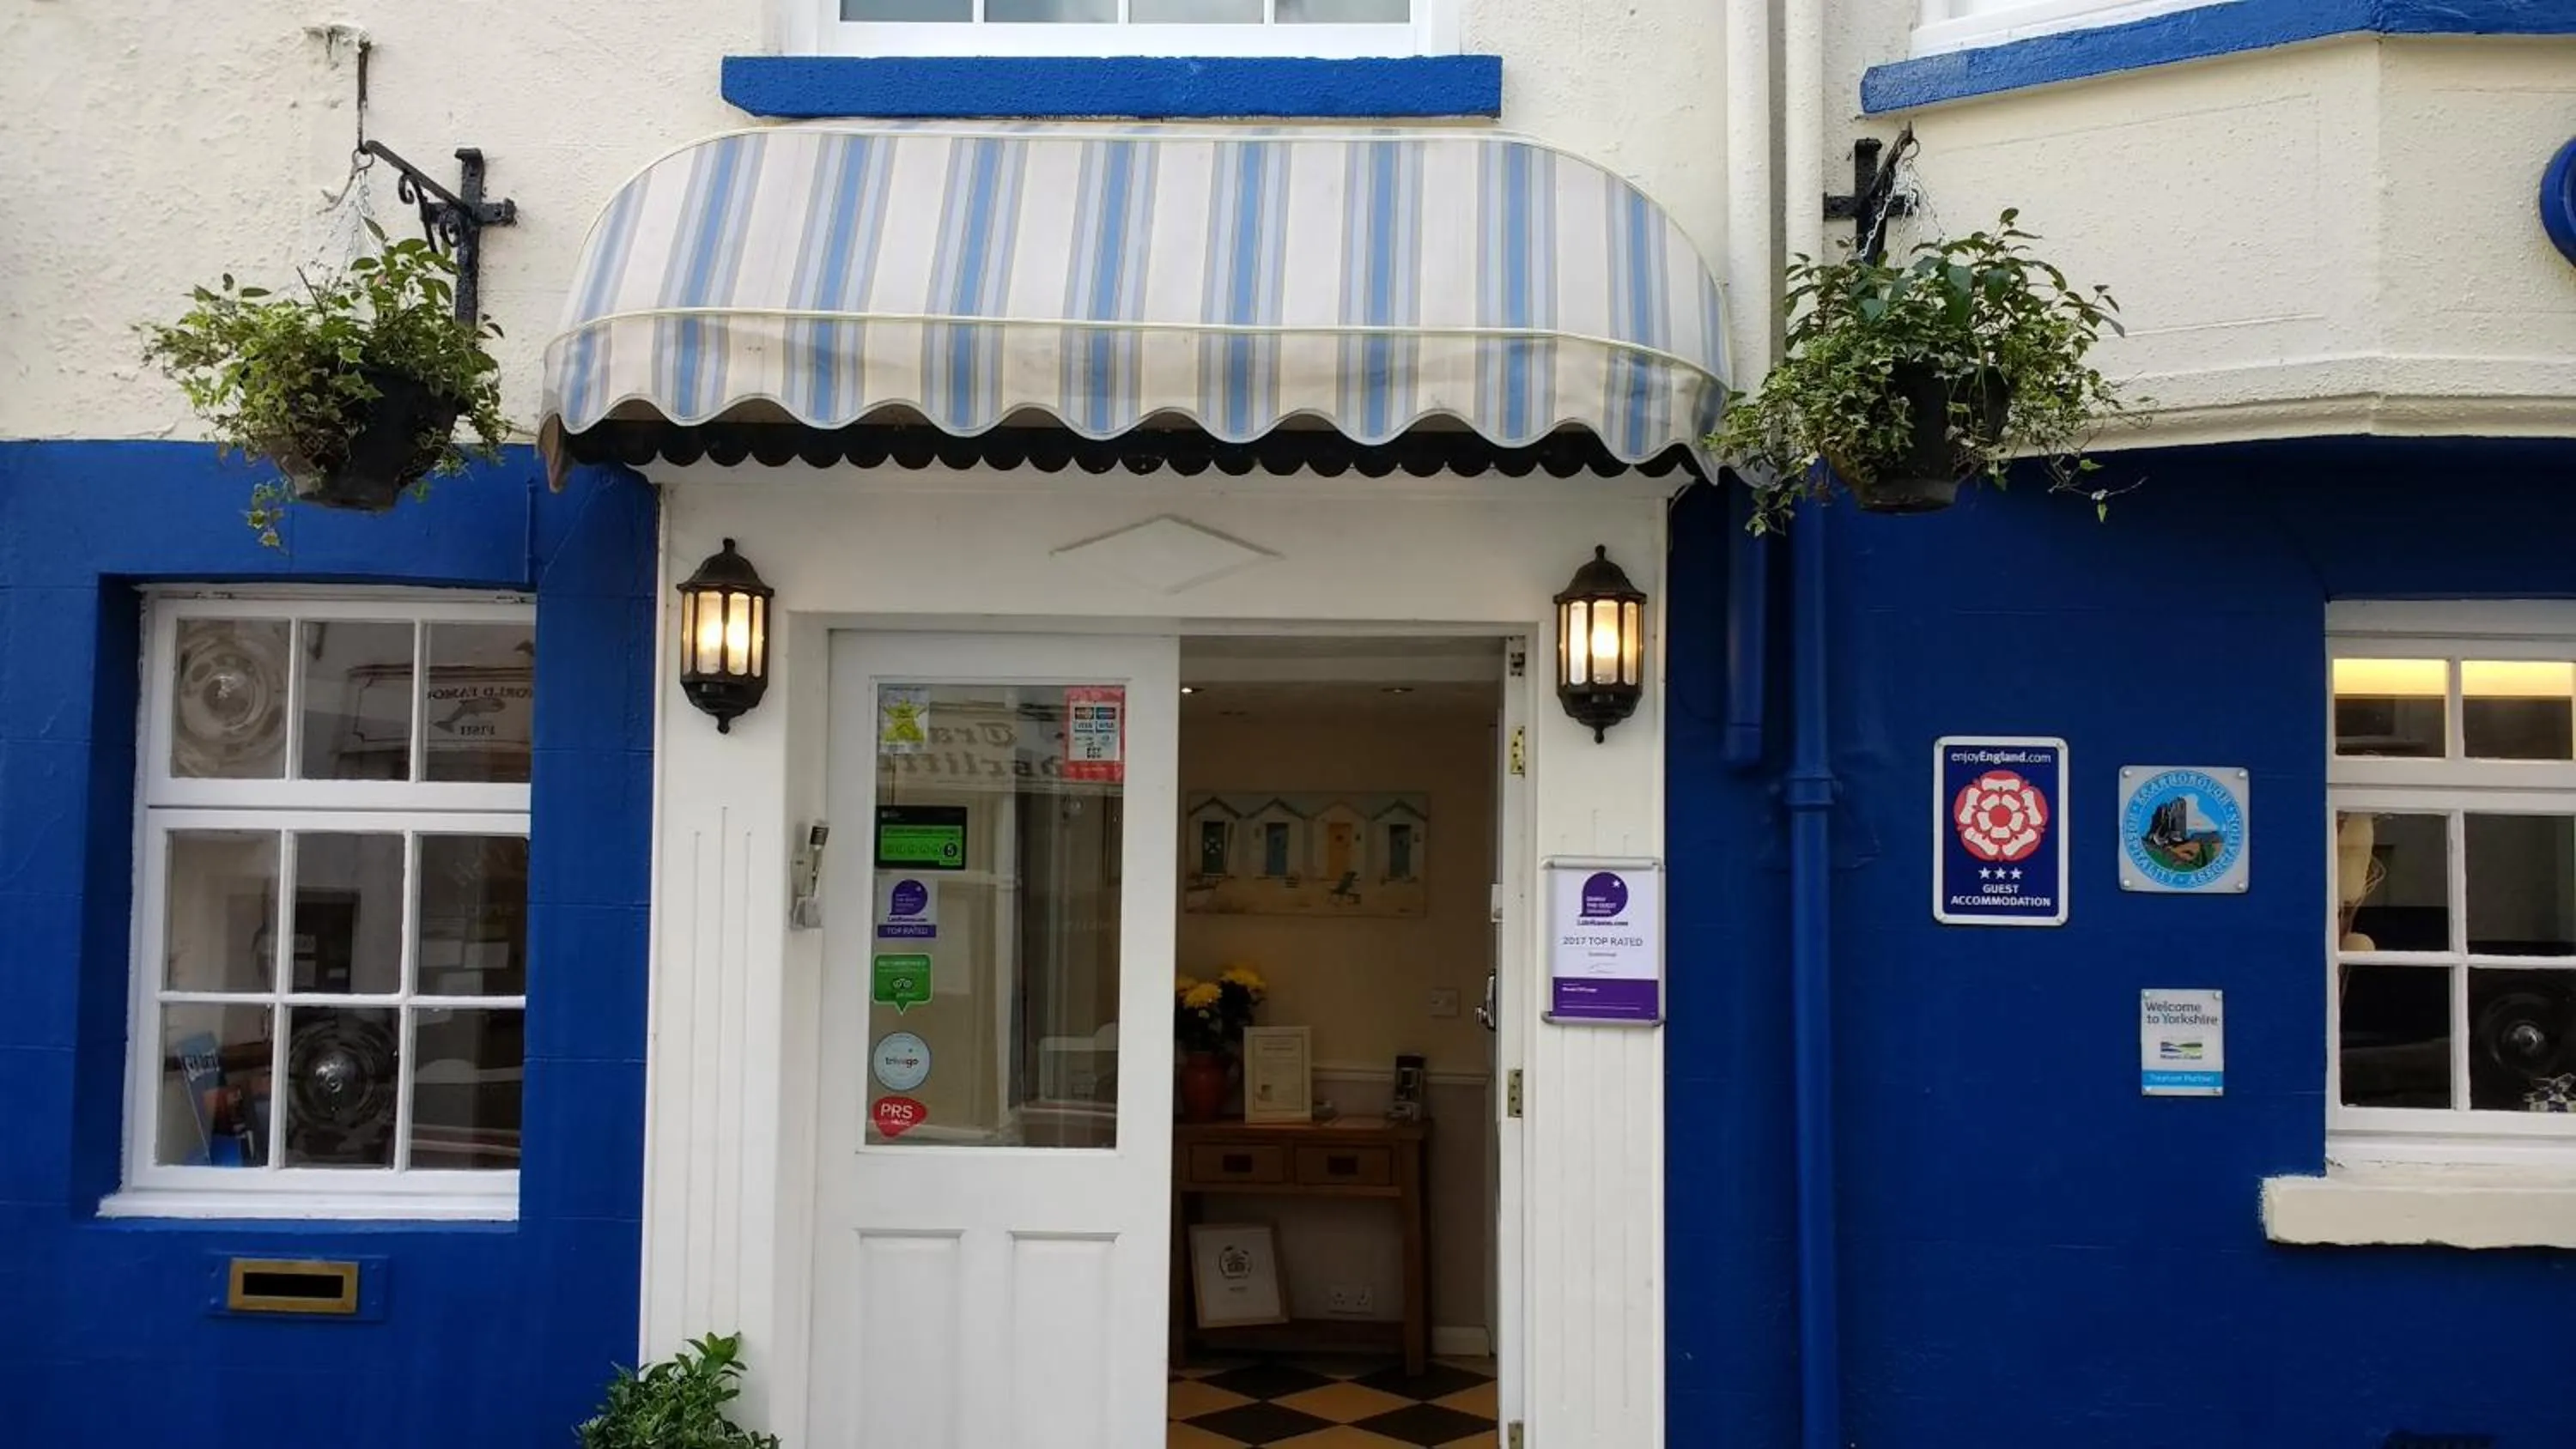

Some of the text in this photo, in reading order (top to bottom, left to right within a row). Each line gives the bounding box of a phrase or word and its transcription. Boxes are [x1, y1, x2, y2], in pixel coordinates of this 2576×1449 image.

[1951, 750, 2051, 765] enjoyEngland.com
[1983, 884, 2020, 894] GUEST
[1951, 895, 2051, 907] ACCOMMODATION
[1564, 936, 1643, 947] 2017 TOP RATED
[2146, 1000, 2202, 1013] Welcome
[2148, 1013, 2218, 1025] to Yorkshire
[880, 1102, 914, 1119] PRS
